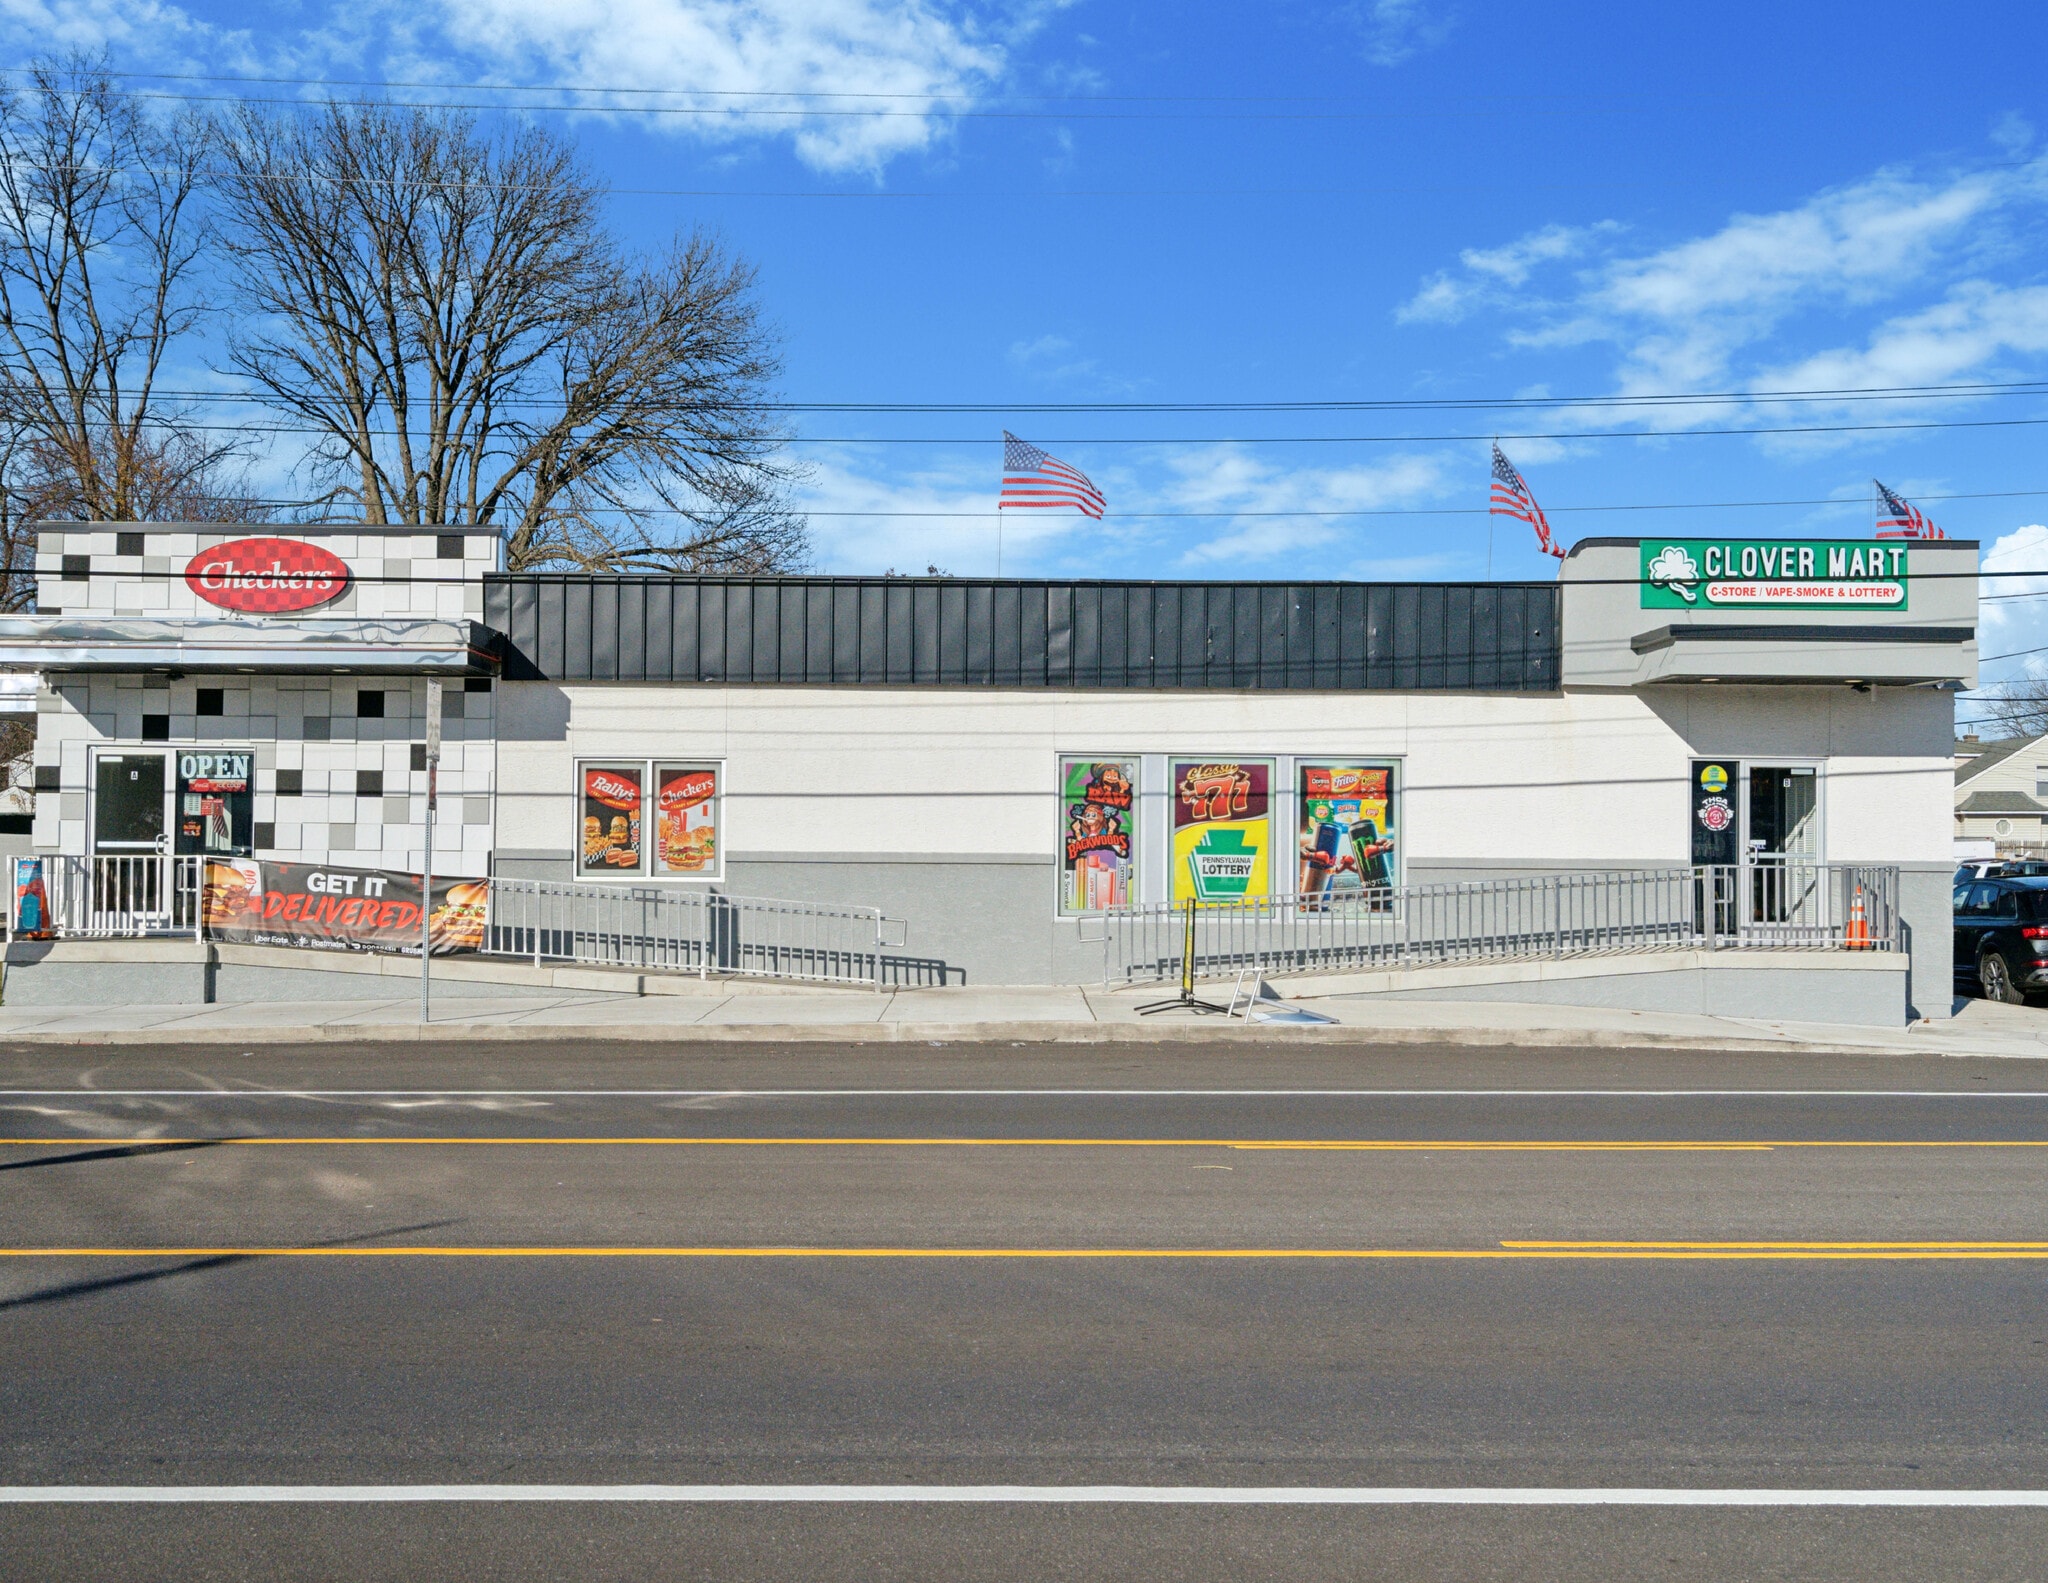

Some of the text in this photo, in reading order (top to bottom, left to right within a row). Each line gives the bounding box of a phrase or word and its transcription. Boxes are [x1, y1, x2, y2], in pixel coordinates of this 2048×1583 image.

[199, 560, 332, 589] Checkers
[1705, 546, 1904, 579] CLOVER MART
[1711, 587, 1757, 597] C-STORE
[1765, 587, 1835, 597] VAPE-SMOKE
[1837, 587, 1846, 597] &
[1848, 588, 1897, 598] LOTTERY
[181, 755, 249, 779] OPEN
[1186, 764, 1239, 780] Classic
[591, 776, 635, 801] Rally's
[659, 779, 714, 806] Checkers
[1334, 775, 1358, 788] Fritos
[1087, 787, 1131, 807] RAW
[1067, 835, 1128, 859] BACKWOODS
[1202, 865, 1251, 875] LOTTERY
[306, 872, 388, 897] GET IT
[263, 890, 424, 932] DELIVERED!
